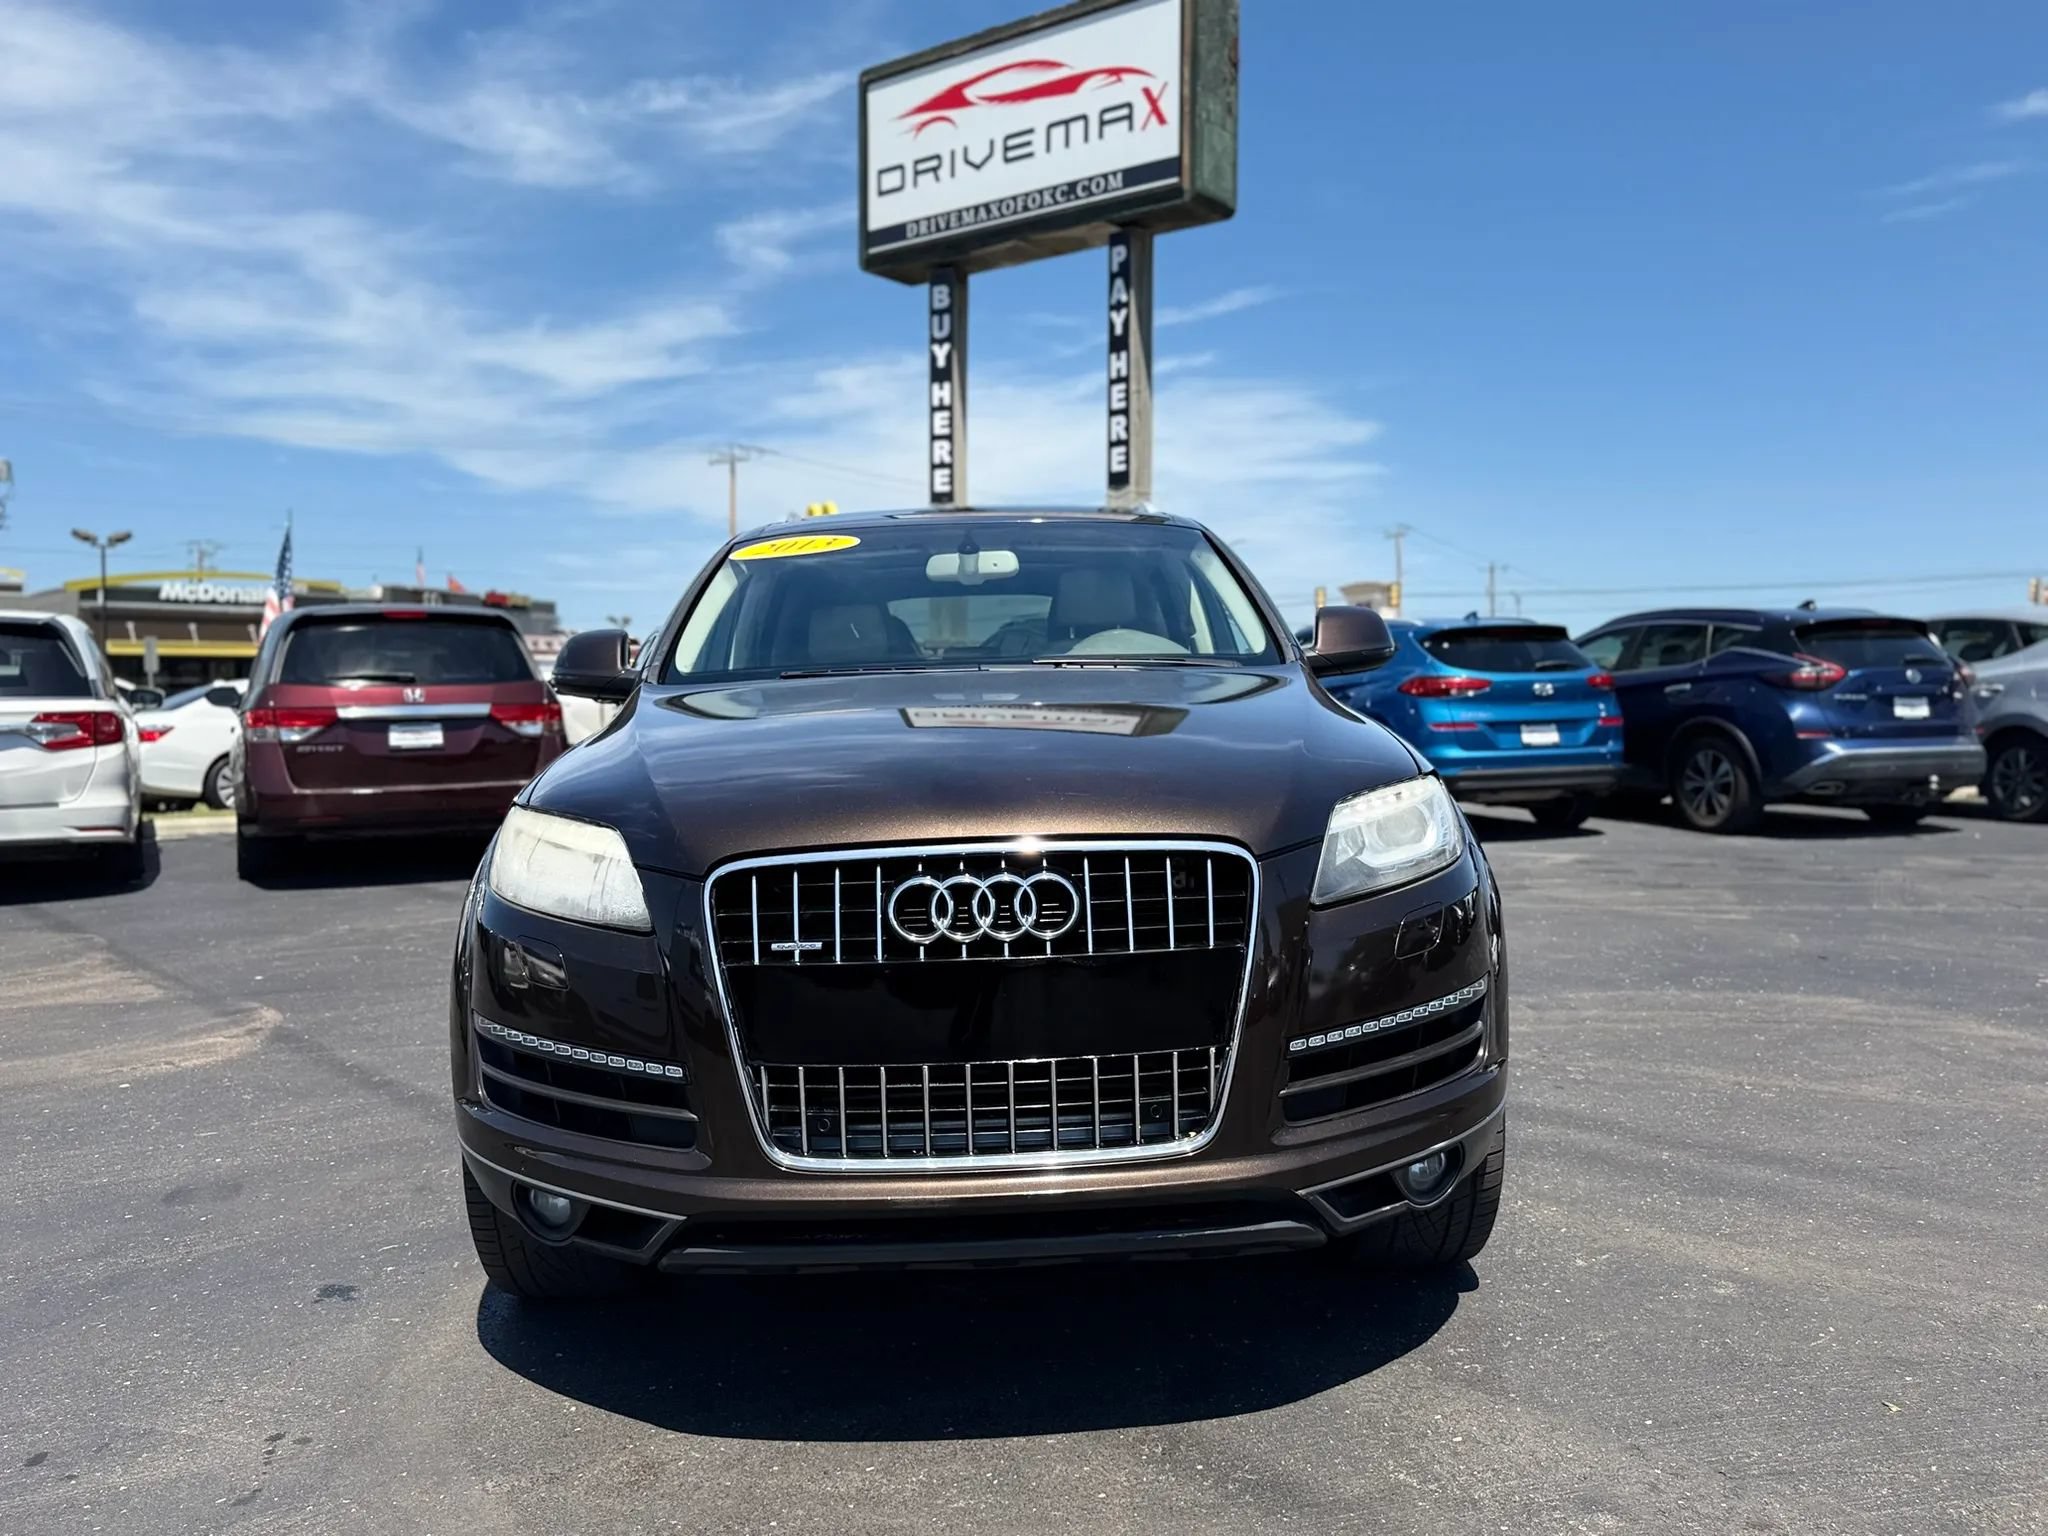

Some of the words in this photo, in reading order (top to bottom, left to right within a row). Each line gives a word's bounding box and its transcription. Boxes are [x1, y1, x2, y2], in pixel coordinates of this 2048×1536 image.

[877, 81, 1169, 197] DRIVEMAX
[905, 172, 1124, 239] DRIVEMAXOFOKC.COM
[931, 284, 951, 369] BUY
[1110, 245, 1129, 337] PAY
[931, 381, 952, 494] HERE
[1110, 351, 1129, 474] HERE
